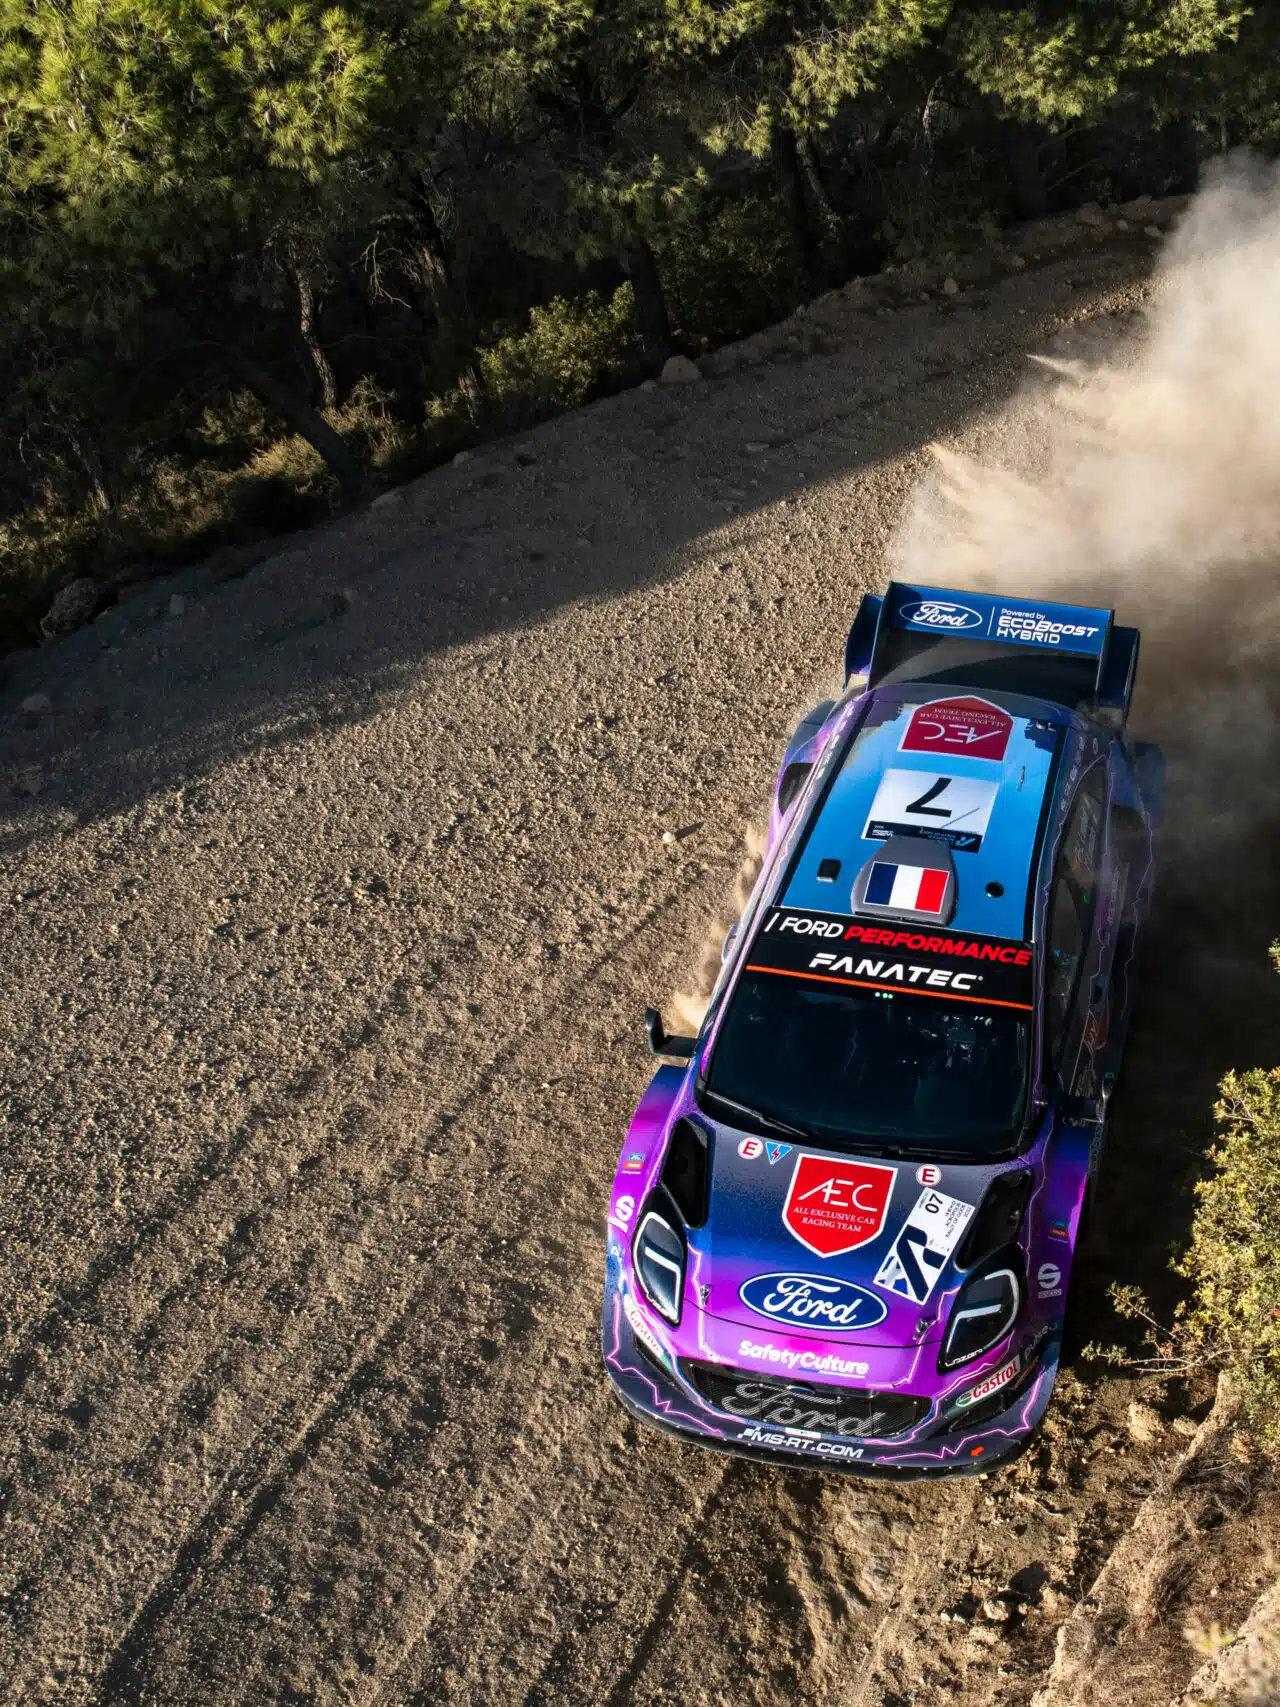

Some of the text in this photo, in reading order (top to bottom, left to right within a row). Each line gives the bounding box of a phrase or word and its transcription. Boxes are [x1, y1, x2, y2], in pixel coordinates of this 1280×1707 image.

[913, 602, 967, 627] Ford
[1001, 608, 1046, 621] Powered by
[996, 626, 1061, 645] HYBRID
[998, 616, 1099, 638] ECOBOOST
[905, 777, 952, 818] 7
[779, 916, 844, 938] FORD
[843, 925, 1032, 966] PERFORMANCE
[809, 952, 977, 990] FANATEC
[743, 1141, 758, 1156] E
[922, 1168, 935, 1183] E
[925, 1193, 943, 1214] 07
[793, 1206, 875, 1225] ALL EXCLUSIVE CAR
[802, 1217, 861, 1232] RACING TEAM
[763, 1278, 863, 1324] Ford
[739, 1340, 869, 1375] SafetyCulture
[972, 1361, 1018, 1399] Castrol
[722, 1383, 887, 1438] Ford
